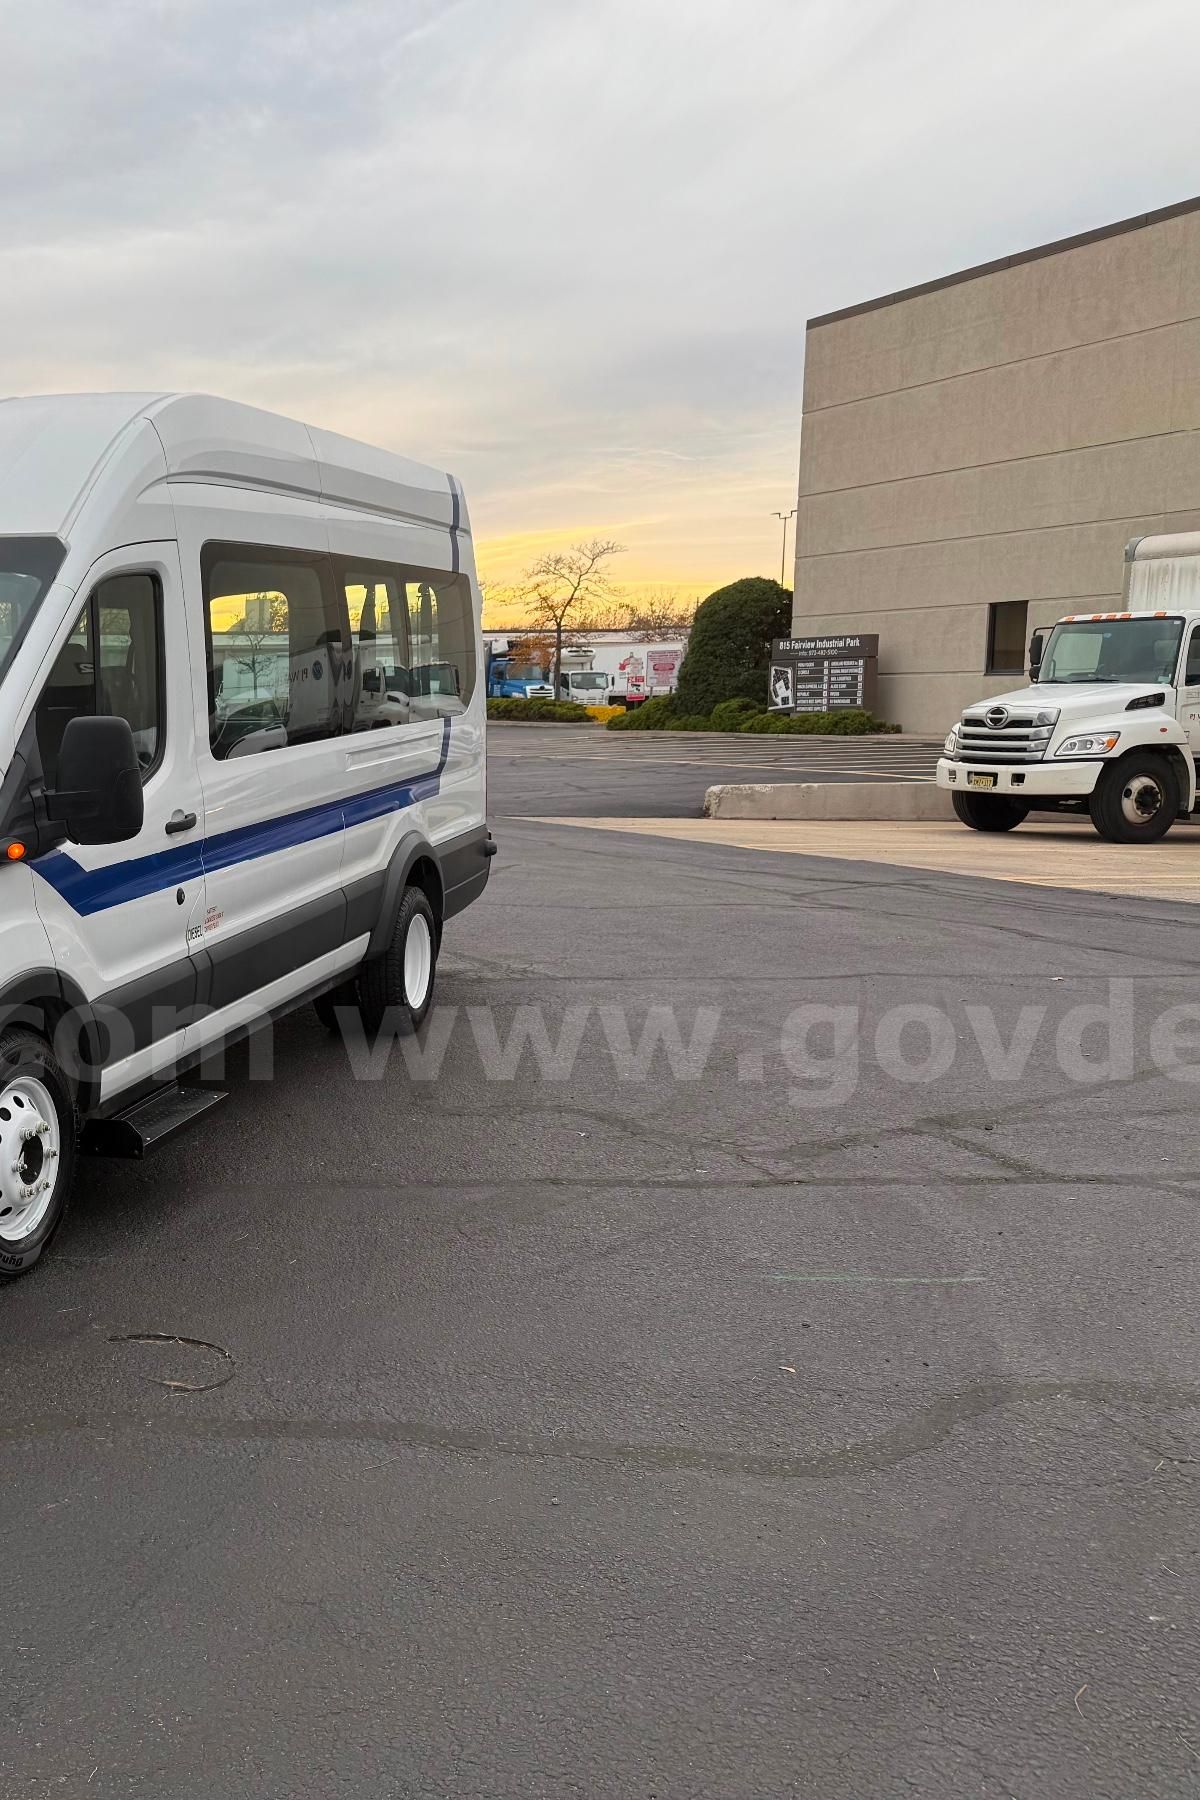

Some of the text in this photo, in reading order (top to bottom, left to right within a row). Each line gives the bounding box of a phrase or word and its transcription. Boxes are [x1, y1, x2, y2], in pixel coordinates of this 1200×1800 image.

[791, 640, 816, 650] Fairview
[816, 638, 845, 649] Industrial
[845, 638, 860, 647] Park
